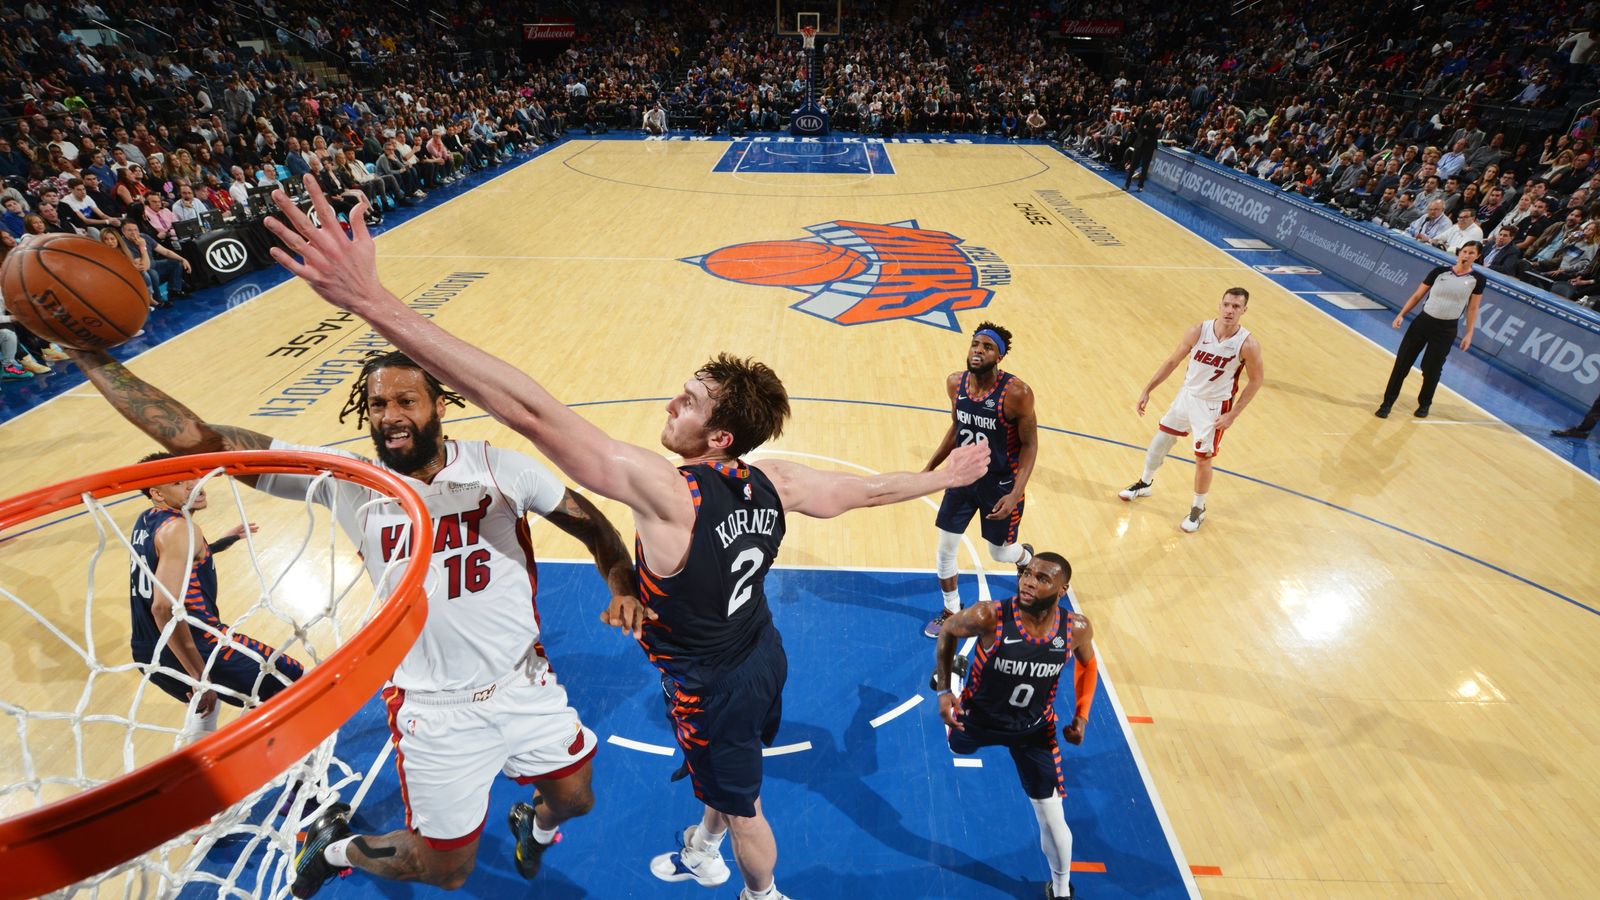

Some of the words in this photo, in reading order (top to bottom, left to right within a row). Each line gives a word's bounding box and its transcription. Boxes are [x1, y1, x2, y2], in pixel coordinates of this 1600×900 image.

[525, 26, 575, 40] Budweiser
[1064, 20, 1120, 34] Budweiser
[800, 118, 818, 128] KIA
[1153, 158, 1183, 183] TACKLE
[1180, 170, 1204, 192] KIDS
[1200, 179, 1271, 224] CANCER.ORG
[1013, 202, 1053, 225] CHASE
[210, 243, 244, 269] KIA
[1298, 224, 1340, 254] Hackensack
[1338, 243, 1377, 271] Meridian
[1375, 261, 1409, 287] Health
[834, 219, 996, 327] KNICKS
[977, 264, 1011, 287] YORK
[406, 271, 490, 310] MADISON
[266, 310, 354, 359] HASE
[1193, 349, 1237, 370] HEAT
[1518, 326, 1600, 385] KIDS
[249, 359, 364, 418] GARDEN
[1208, 369, 1225, 382] 7
[956, 409, 971, 425] NEW
[972, 414, 997, 430] YORK
[380, 493, 493, 563] HAT
[715, 508, 778, 549] KORNET
[443, 548, 491, 600] 16
[727, 546, 764, 617] 2
[993, 656, 1028, 676] NEW
[1029, 661, 1064, 678] YORK
[1008, 683, 1035, 708] 0
